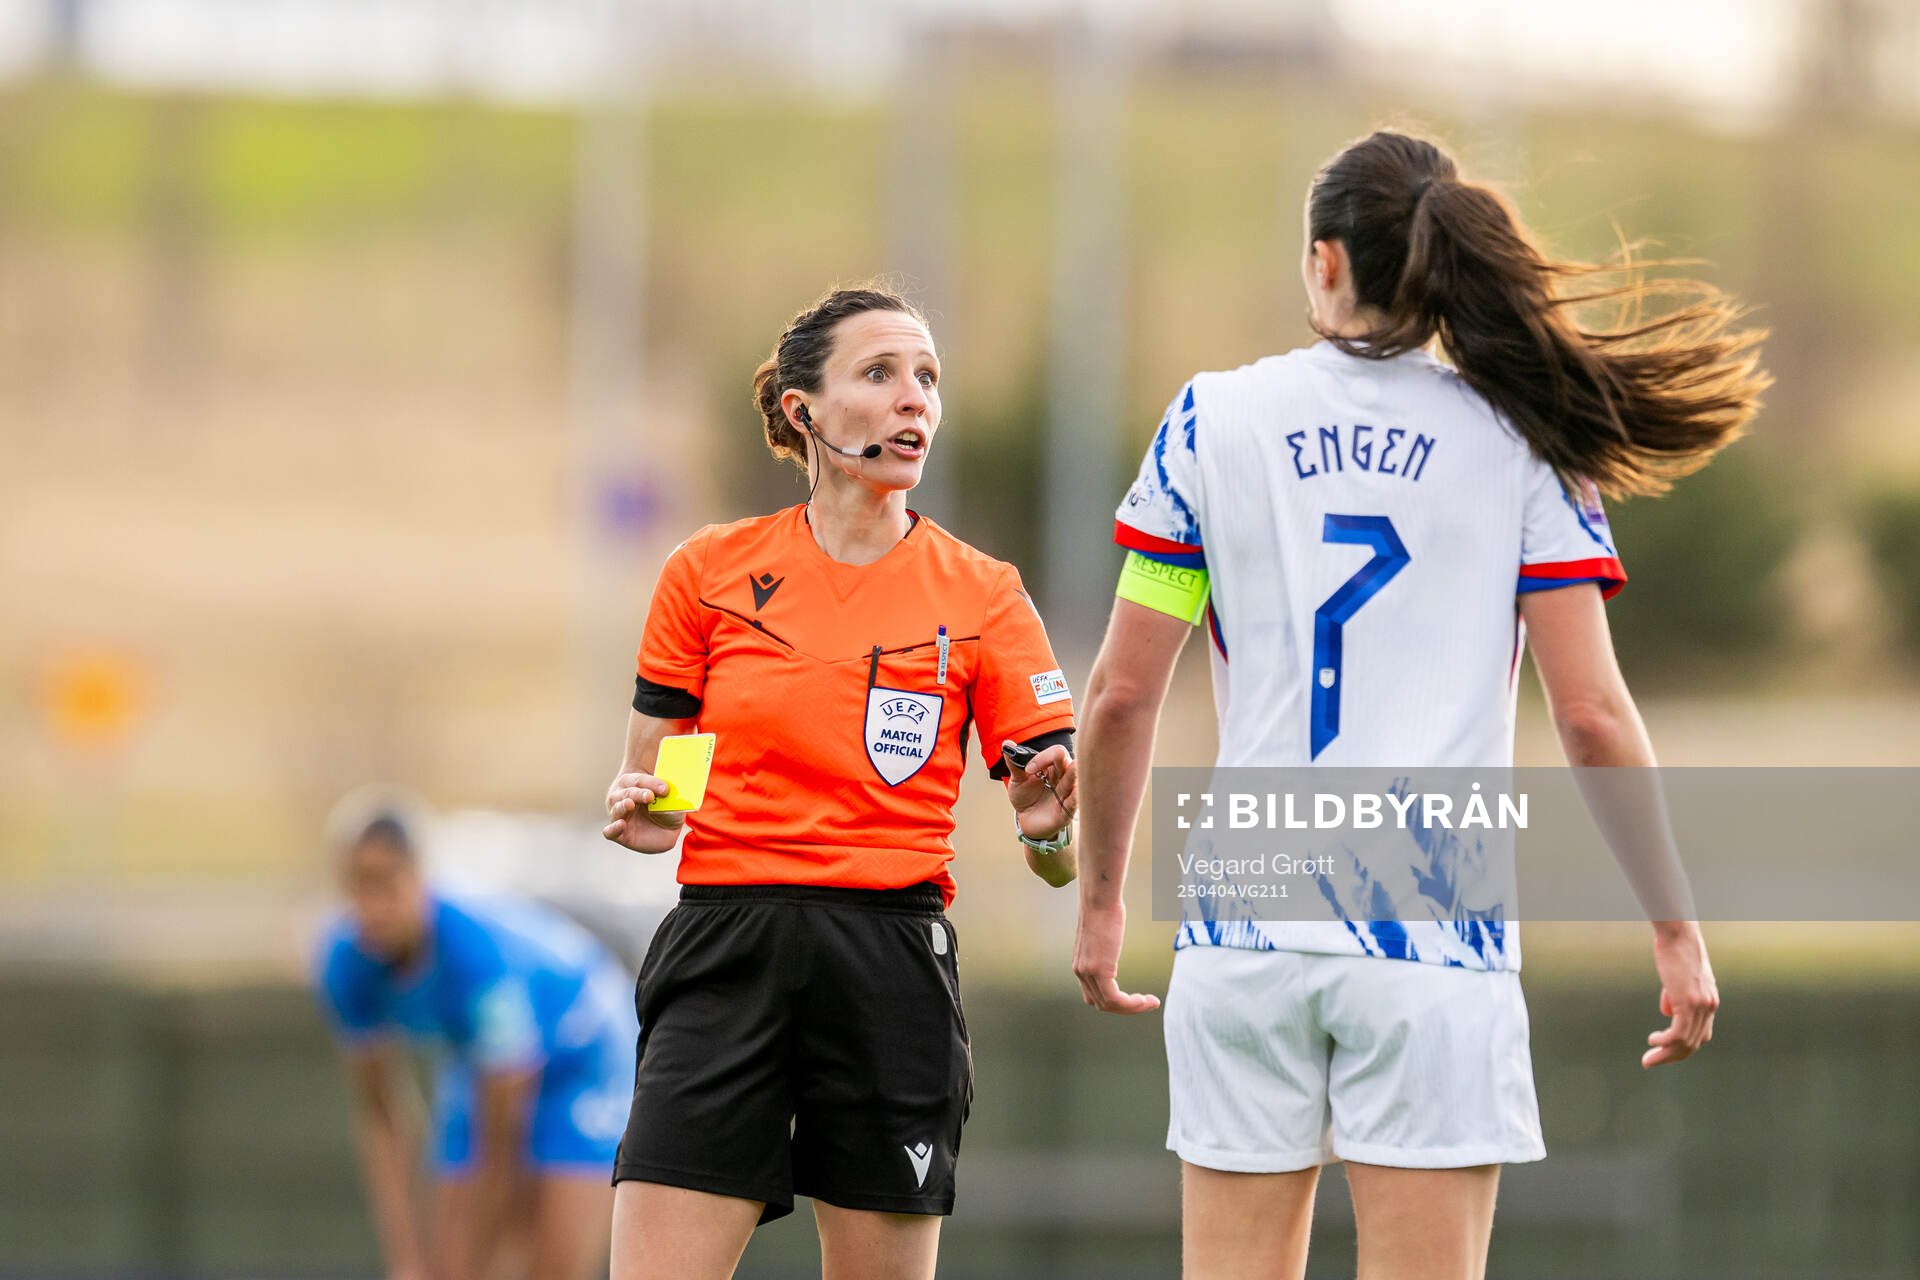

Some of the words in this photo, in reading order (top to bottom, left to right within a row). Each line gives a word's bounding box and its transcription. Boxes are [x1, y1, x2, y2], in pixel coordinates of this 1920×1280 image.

[1286, 425, 1437, 482] ENGEN
[1133, 554, 1198, 587] RESPECT
[1311, 513, 1411, 762] 7
[1032, 675, 1048, 683] UEFA
[882, 701, 925, 722] UEFA
[880, 728, 922, 744] MATCH
[873, 742, 923, 758] OFFICIAL
